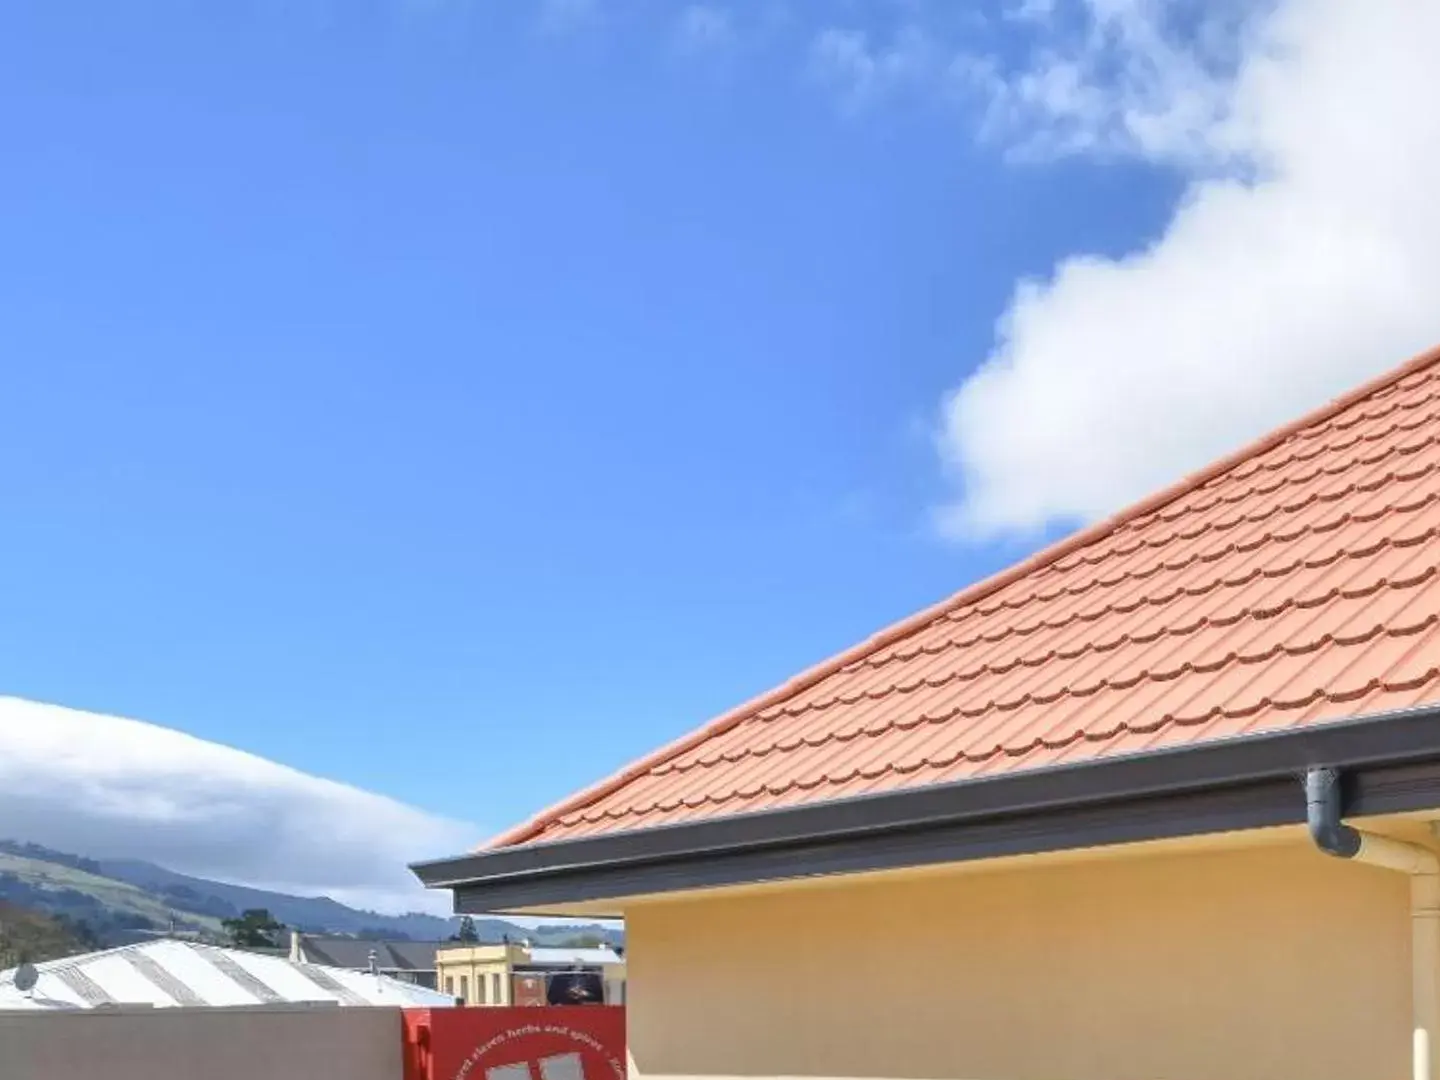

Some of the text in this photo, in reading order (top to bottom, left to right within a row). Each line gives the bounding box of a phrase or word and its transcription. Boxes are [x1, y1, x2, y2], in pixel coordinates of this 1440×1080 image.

[472, 1033, 506, 1060] eleven
[506, 1024, 541, 1039] herbs
[544, 1024, 569, 1036] and
[570, 1029, 604, 1051] spices
